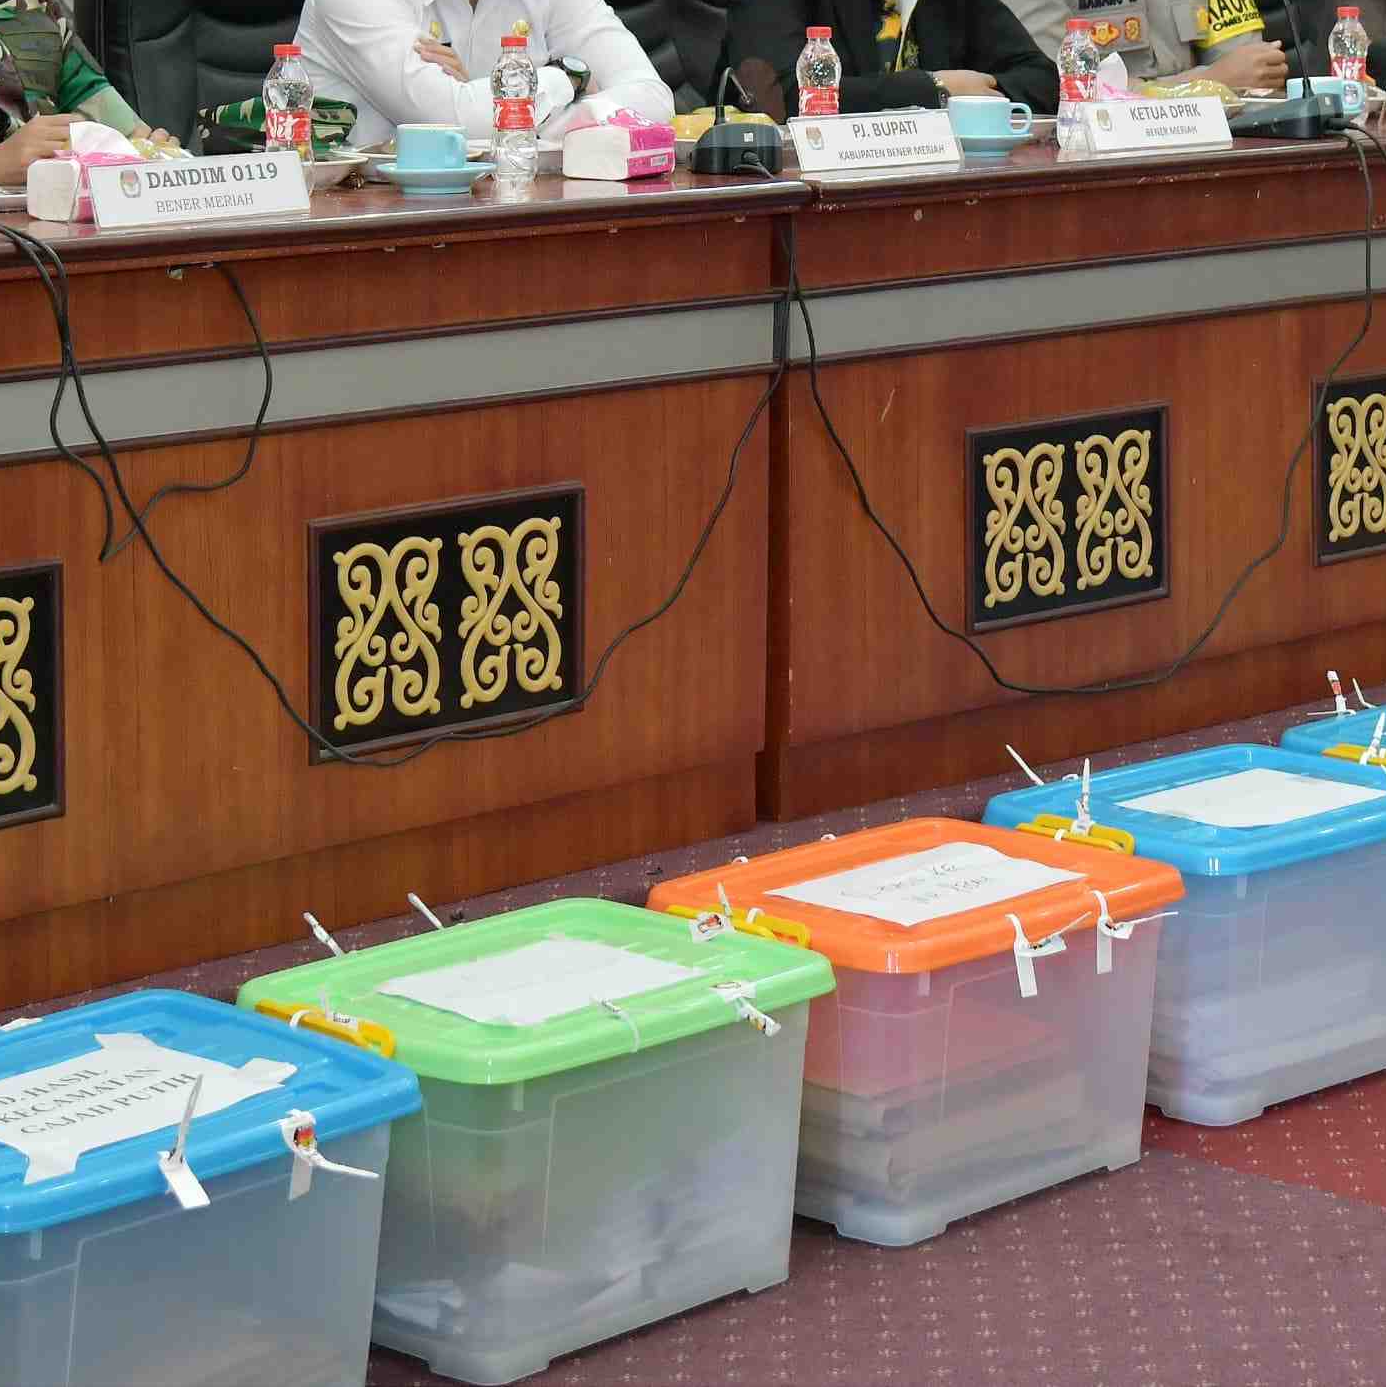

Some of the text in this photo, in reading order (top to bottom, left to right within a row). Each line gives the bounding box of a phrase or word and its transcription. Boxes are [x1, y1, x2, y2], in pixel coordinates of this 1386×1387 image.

[1129, 102, 1202, 121] KETUA DPRK
[852, 119, 918, 139] PJ. BUPATI
[838, 143, 946, 161] KABUPATEN BENER MERIAH
[146, 161, 279, 189] DANDIM 0119
[156, 192, 254, 215] BENER MERIAH
[20, 1072, 199, 1135] GAJAH PUTIH
